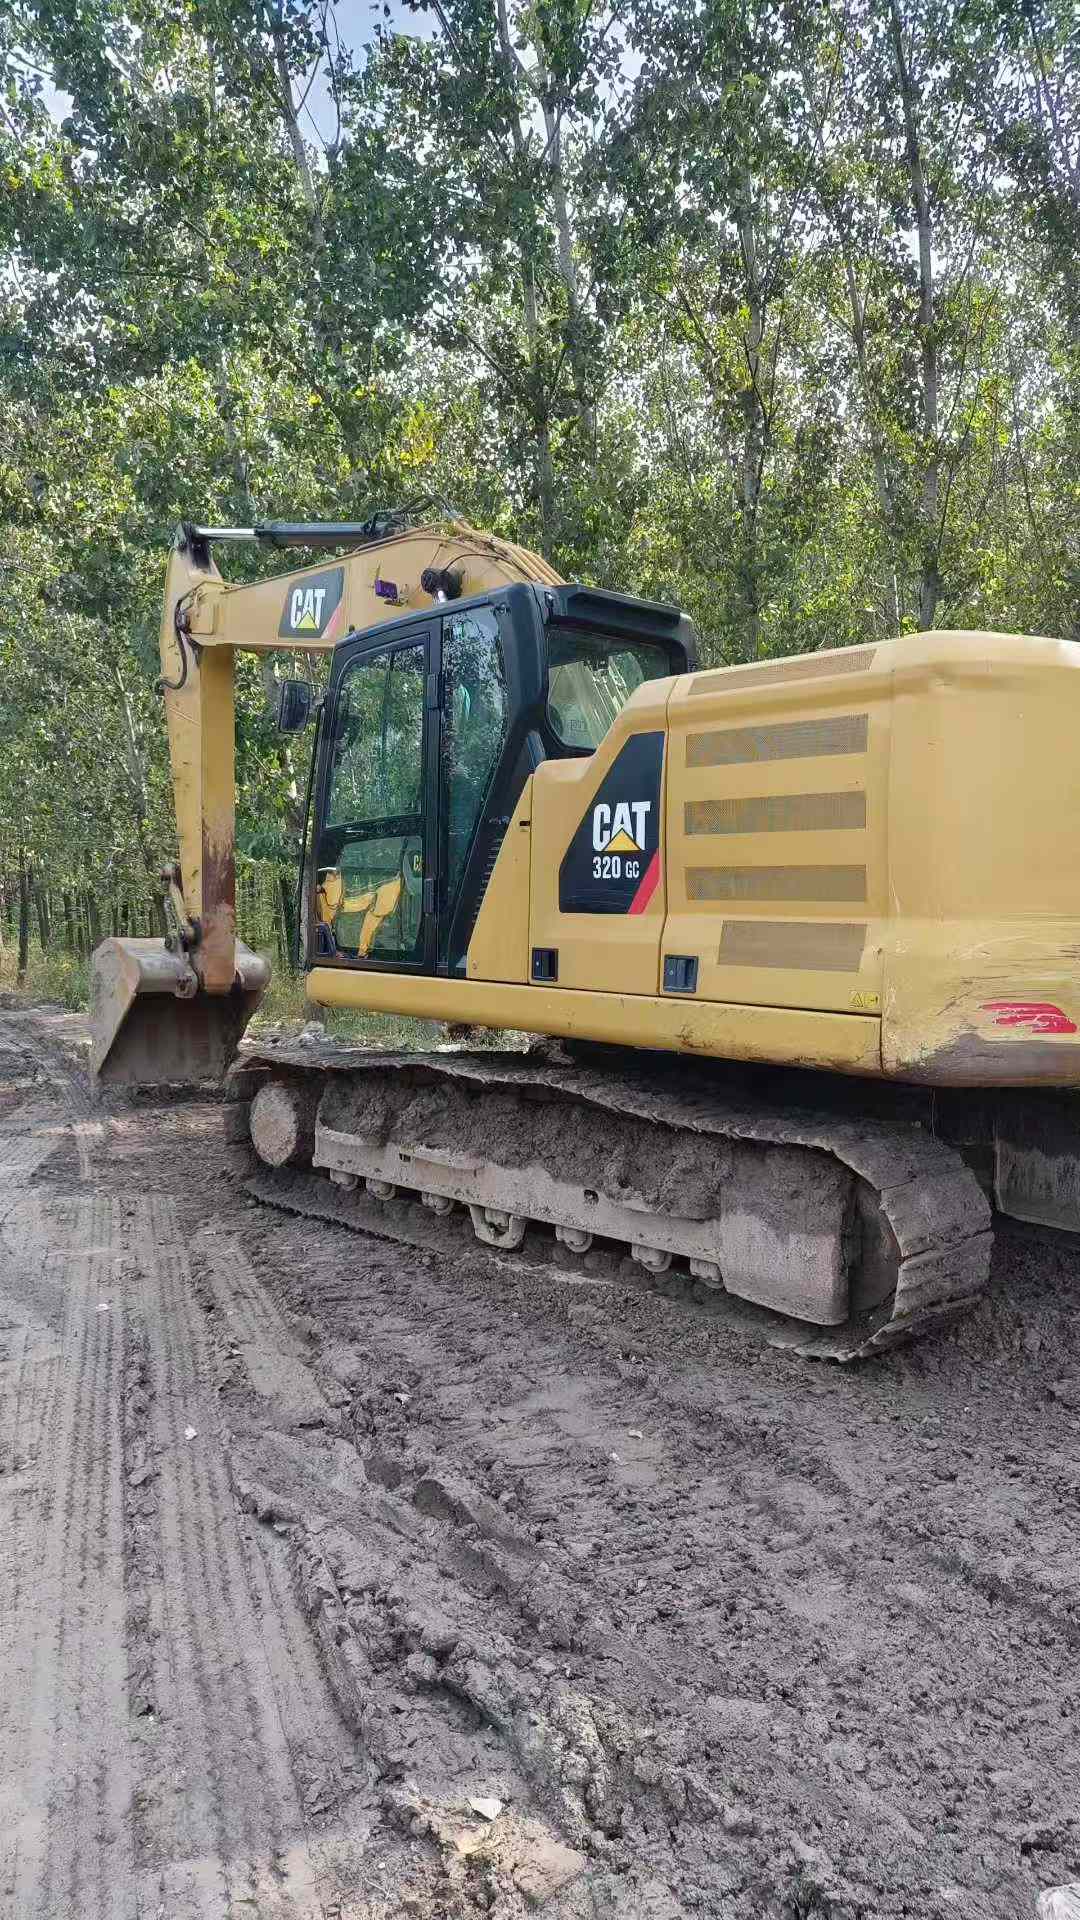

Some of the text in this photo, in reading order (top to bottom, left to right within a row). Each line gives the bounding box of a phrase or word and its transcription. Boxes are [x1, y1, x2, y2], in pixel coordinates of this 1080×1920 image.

[290, 588, 326, 629] CAT
[592, 801, 651, 852] CAT
[592, 856, 640, 879] 320 GC
